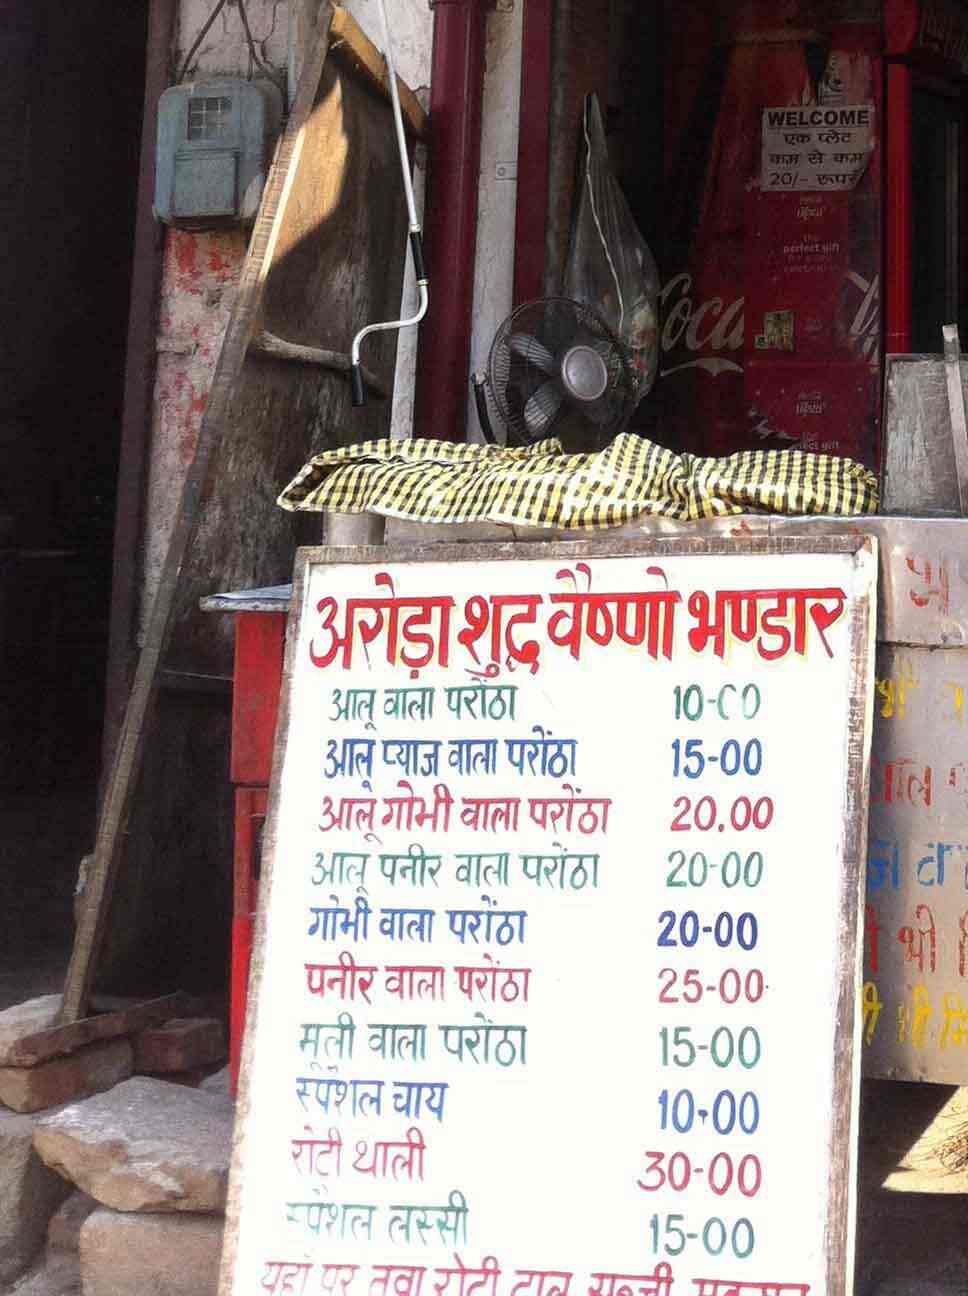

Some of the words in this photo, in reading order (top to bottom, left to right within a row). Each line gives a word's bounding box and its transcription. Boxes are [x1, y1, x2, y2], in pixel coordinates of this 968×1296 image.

[768, 110, 869, 125] WELCOME
[783, 132, 811, 145] एक
[770, 172, 808, 186] 20/-
[310, 572, 456, 679] अरोड़ा
[687, 587, 847, 661] भण्डार
[328, 688, 376, 730] आलू
[383, 687, 435, 721] वाला
[324, 738, 376, 792] आलू
[382, 740, 442, 776] प्याज
[448, 739, 498, 776] वाला
[672, 738, 762, 779] 15-00
[319, 796, 382, 844] आलू
[382, 780, 453, 832] गोभी
[460, 798, 521, 832] वाला
[670, 796, 773, 832] 20.00
[311, 852, 371, 895] आलू
[379, 843, 442, 887] पनीर
[454, 853, 510, 887] वाला
[666, 850, 763, 888] 20-00
[308, 894, 372, 942] गोभी
[379, 908, 435, 942] वाला
[657, 910, 758, 951] 20-00
[304, 951, 378, 1005] पनीर
[385, 966, 446, 1001] वाला
[658, 968, 764, 1004] 25-00
[368, 1024, 427, 1060] वाला
[659, 1026, 761, 1069] 15-00
[393, 1081, 450, 1122] चाय
[292, 1125, 342, 1176] रोटी
[352, 1127, 426, 1181] थाली
[637, 1151, 761, 1197] 30-00
[389, 1189, 469, 1245] लस्सी
[650, 1213, 754, 1258] 15-00
